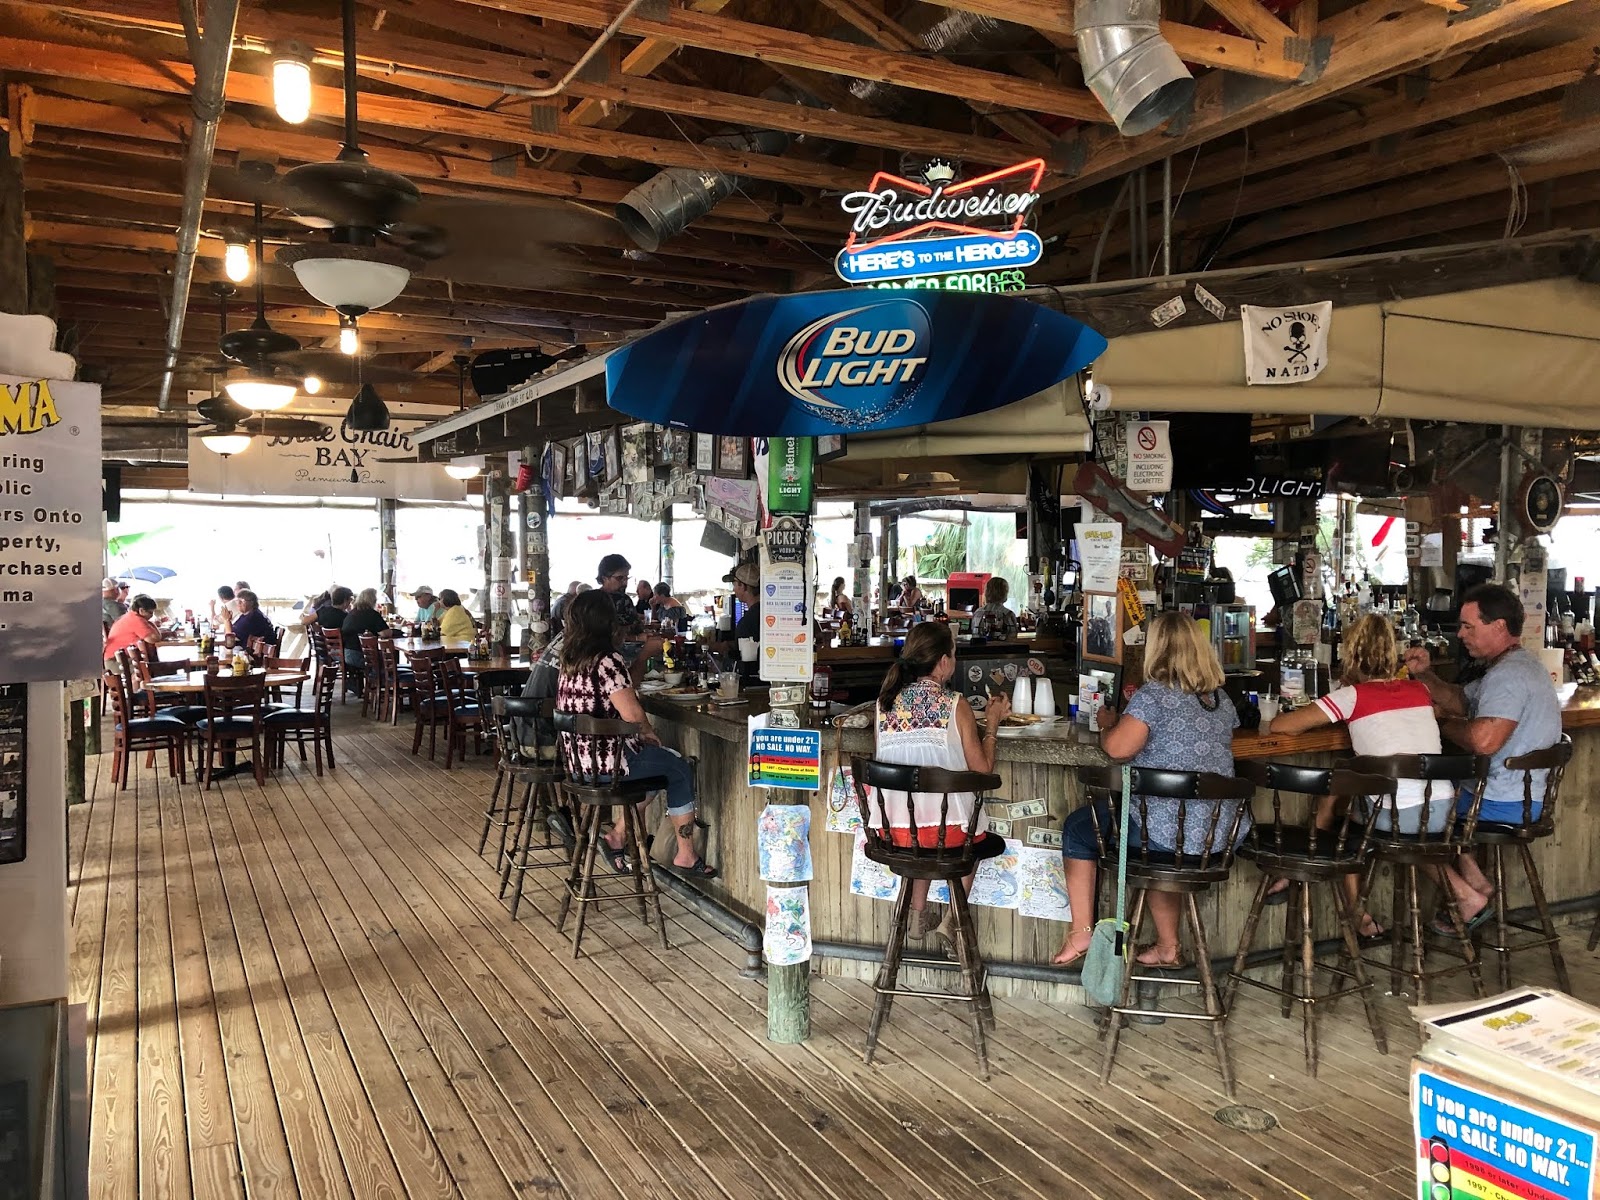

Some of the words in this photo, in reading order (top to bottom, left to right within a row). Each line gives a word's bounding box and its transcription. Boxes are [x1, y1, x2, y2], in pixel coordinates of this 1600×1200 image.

[841, 186, 1040, 232] Budweiser
[849, 250, 916, 273] HERE'S
[917, 252, 933, 264] TO
[934, 250, 954, 262] THE
[955, 240, 1030, 263] HEROES
[1261, 316, 1283, 336] NO
[822, 326, 916, 358] BUD
[800, 357, 927, 389] LIGHT
[3, 454, 44, 473] ring
[315, 447, 368, 468] BAY
[0, 480, 32, 496] lic
[1259, 477, 1321, 497] LIGHT
[0, 510, 24, 522] rs
[34, 508, 82, 523] Onto
[1029, 659, 1043, 673] OBA
[767, 743, 783, 752] SALE.
[785, 744, 794, 753] NO
[796, 744, 812, 754] WAY.
[783, 736, 804, 744] under
[1422, 1085, 1434, 1107] If
[1436, 1094, 1466, 1120] you
[1468, 1107, 1497, 1132] are
[1501, 1119, 1553, 1153] under
[1556, 1138, 1589, 1169] 21...
[1436, 1114, 1458, 1139] NO
[1460, 1124, 1502, 1158] SALE.
[1505, 1142, 1528, 1168] NO
[1531, 1152, 1571, 1187] WAY.
[1467, 1180, 1487, 1193] 1997
